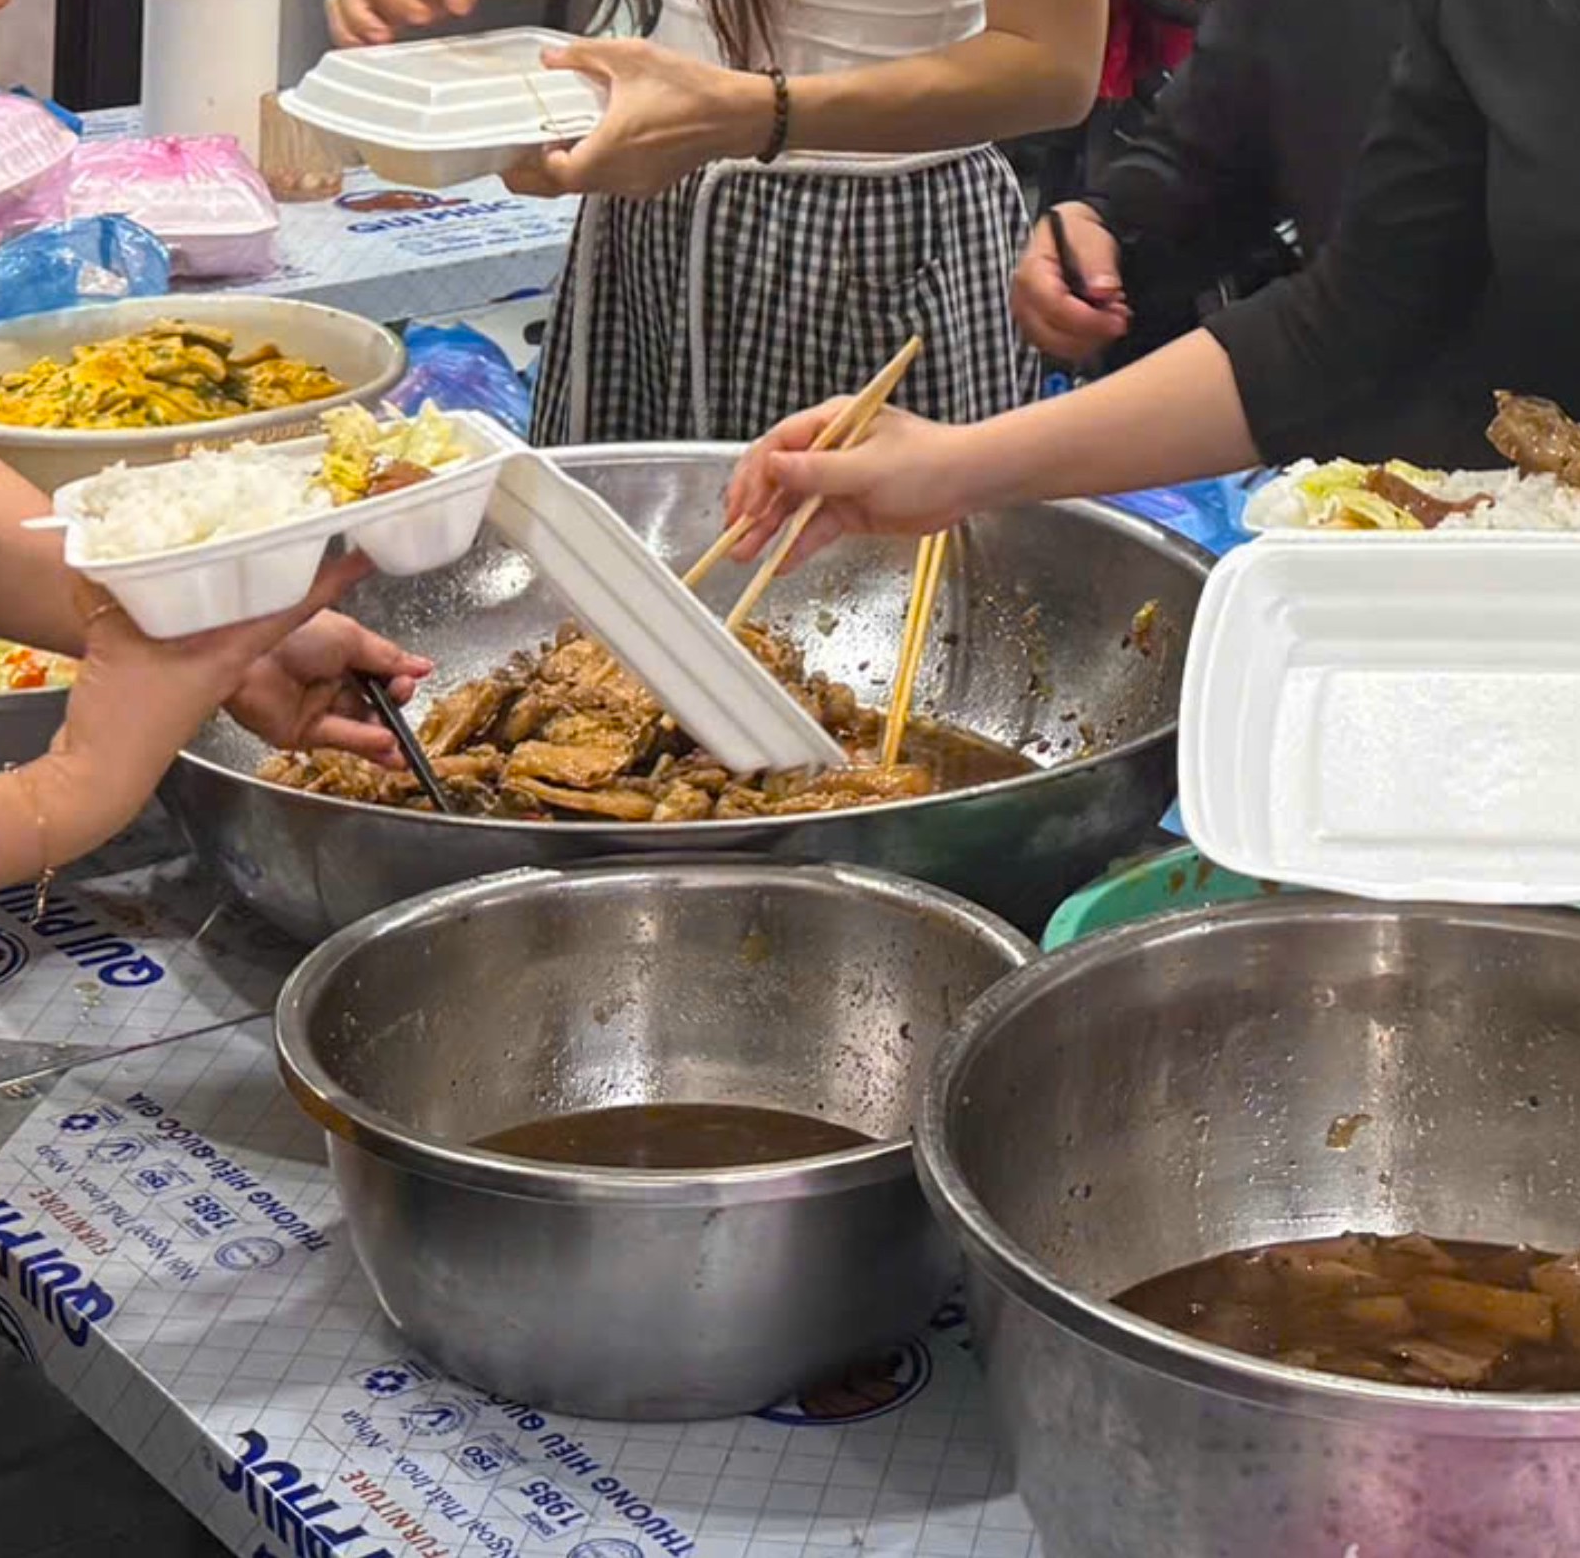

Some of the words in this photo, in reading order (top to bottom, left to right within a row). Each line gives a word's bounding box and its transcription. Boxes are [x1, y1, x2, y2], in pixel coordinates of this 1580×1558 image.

[124, 1092, 164, 1118] GIA
[30, 1187, 118, 1256] FURNITURE
[183, 1194, 237, 1229] 1985
[463, 1445, 501, 1472] ISO
[538, 1433, 602, 1476] HIỆU
[520, 1481, 585, 1528] 1985
